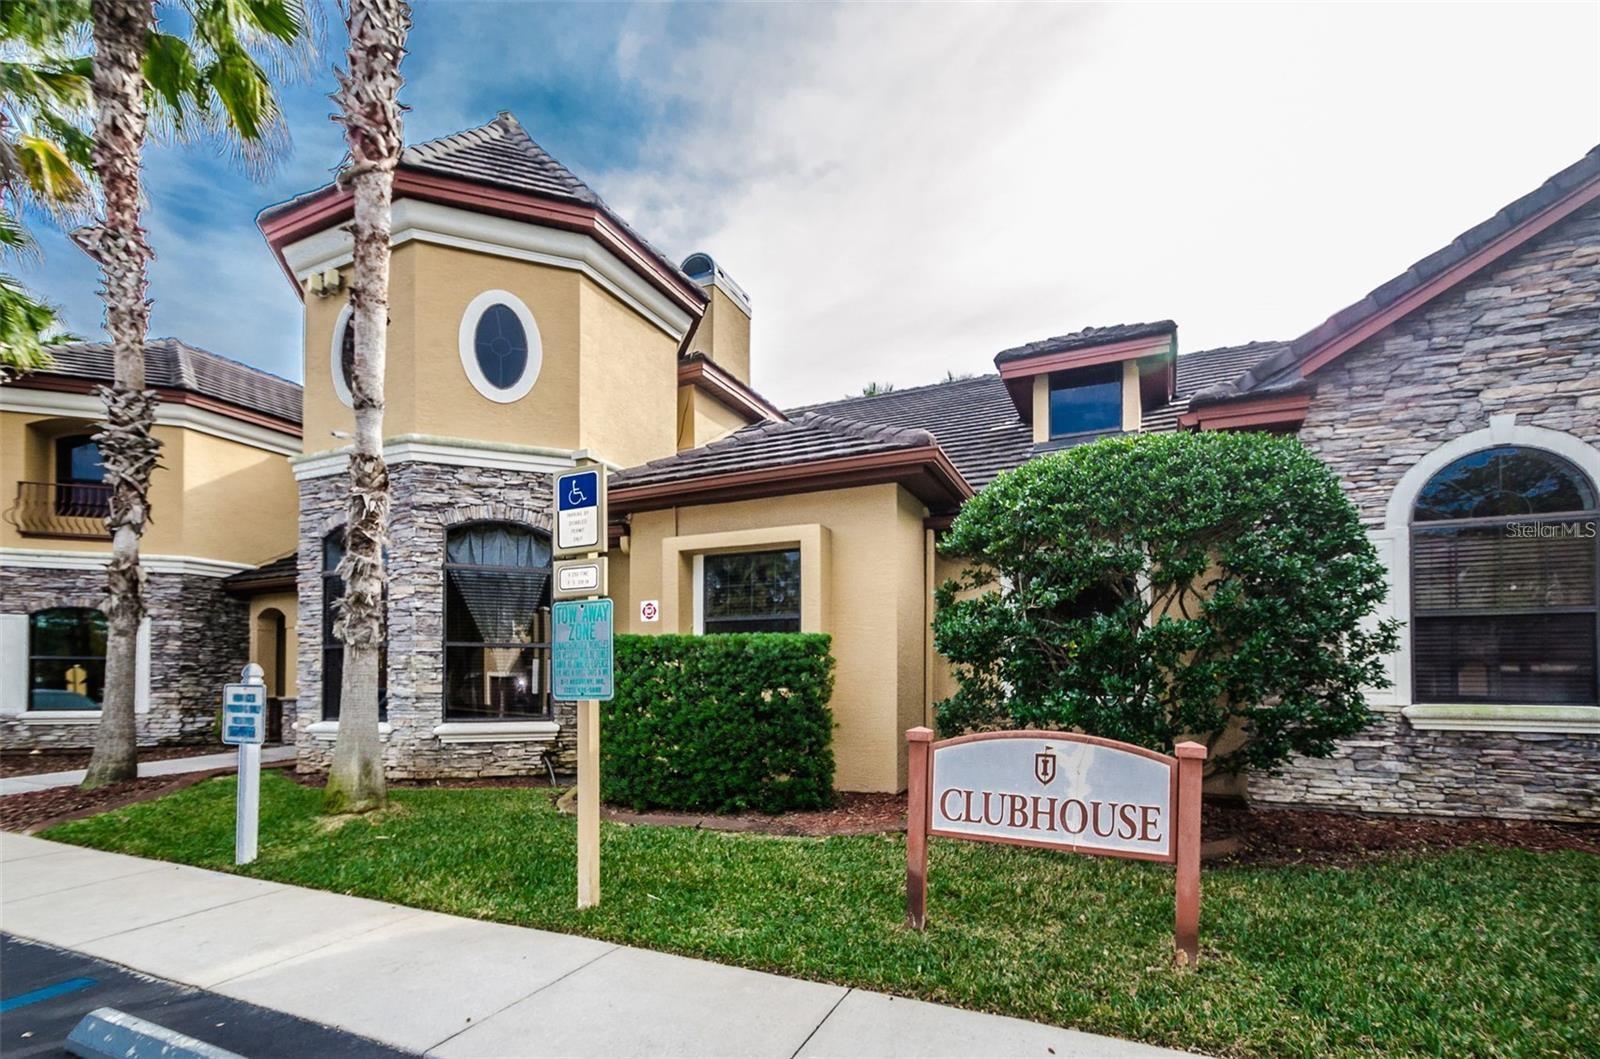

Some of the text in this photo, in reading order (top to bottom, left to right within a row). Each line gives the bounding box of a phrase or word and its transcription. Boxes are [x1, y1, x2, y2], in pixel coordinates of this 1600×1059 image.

[556, 604, 609, 625] TOW AWAY
[568, 622, 596, 641] ZONE
[940, 788, 1162, 842] CLUBHOUSE
